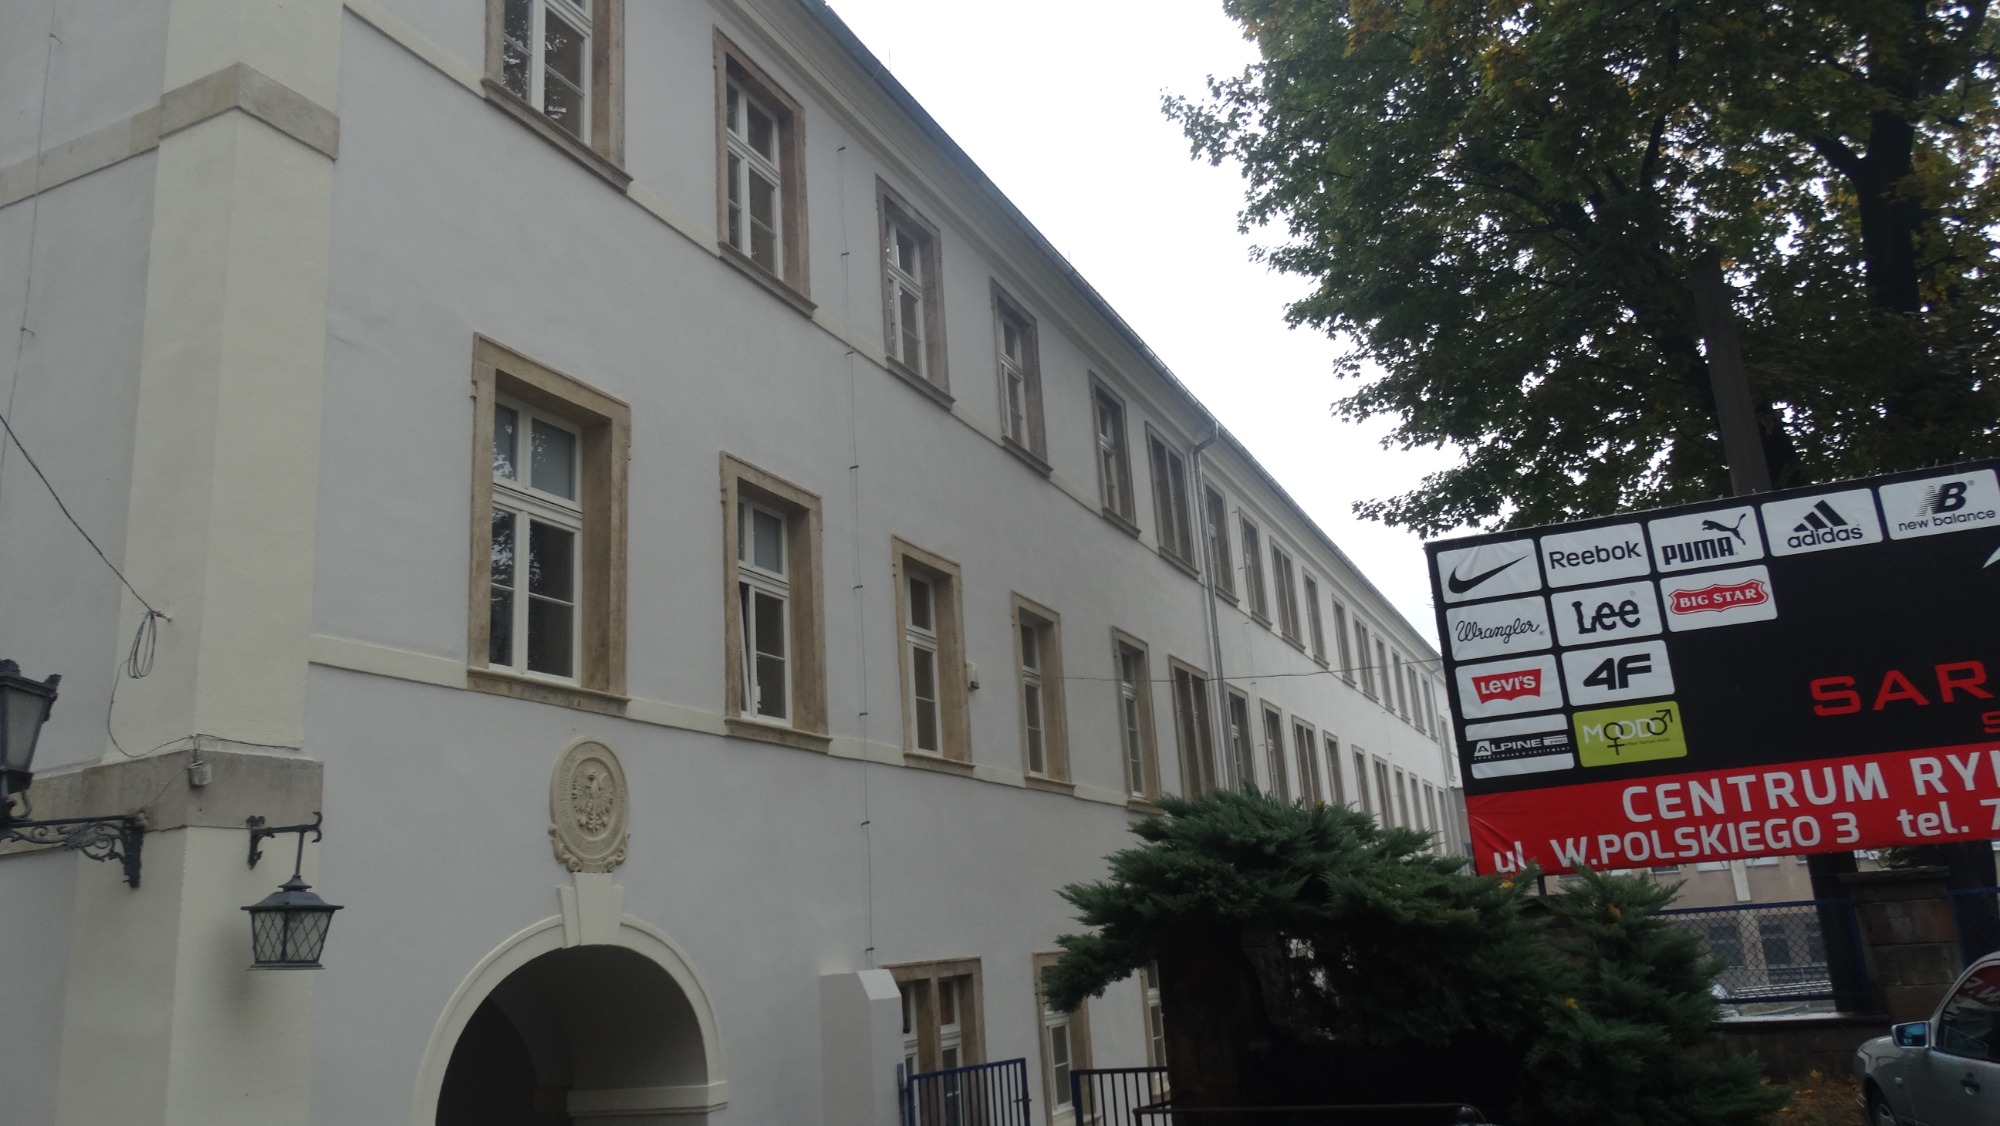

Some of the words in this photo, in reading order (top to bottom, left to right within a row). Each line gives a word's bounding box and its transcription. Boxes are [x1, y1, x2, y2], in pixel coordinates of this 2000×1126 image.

[1898, 519, 1929, 532] new
[1932, 509, 1996, 527] balance
[1661, 536, 1736, 566] PUMA
[1787, 526, 1864, 549] adidas
[1548, 540, 1642, 570] Reebok
[1679, 594, 1709, 608] BIG
[1713, 587, 1758, 604] STAR
[1455, 617, 1540, 644] Wrangler
[1571, 599, 1641, 635] Lee
[1582, 653, 1652, 691] 4F
[1809, 660, 1996, 717] SAR
[1473, 738, 1542, 757] ALPINE
[1622, 761, 1889, 823] CENTRUM
[1493, 840, 1539, 873] ul
[1549, 815, 1821, 868] W.POLSKIEGO
[1831, 812, 1860, 844] 3
[1896, 801, 1969, 838] tel.
